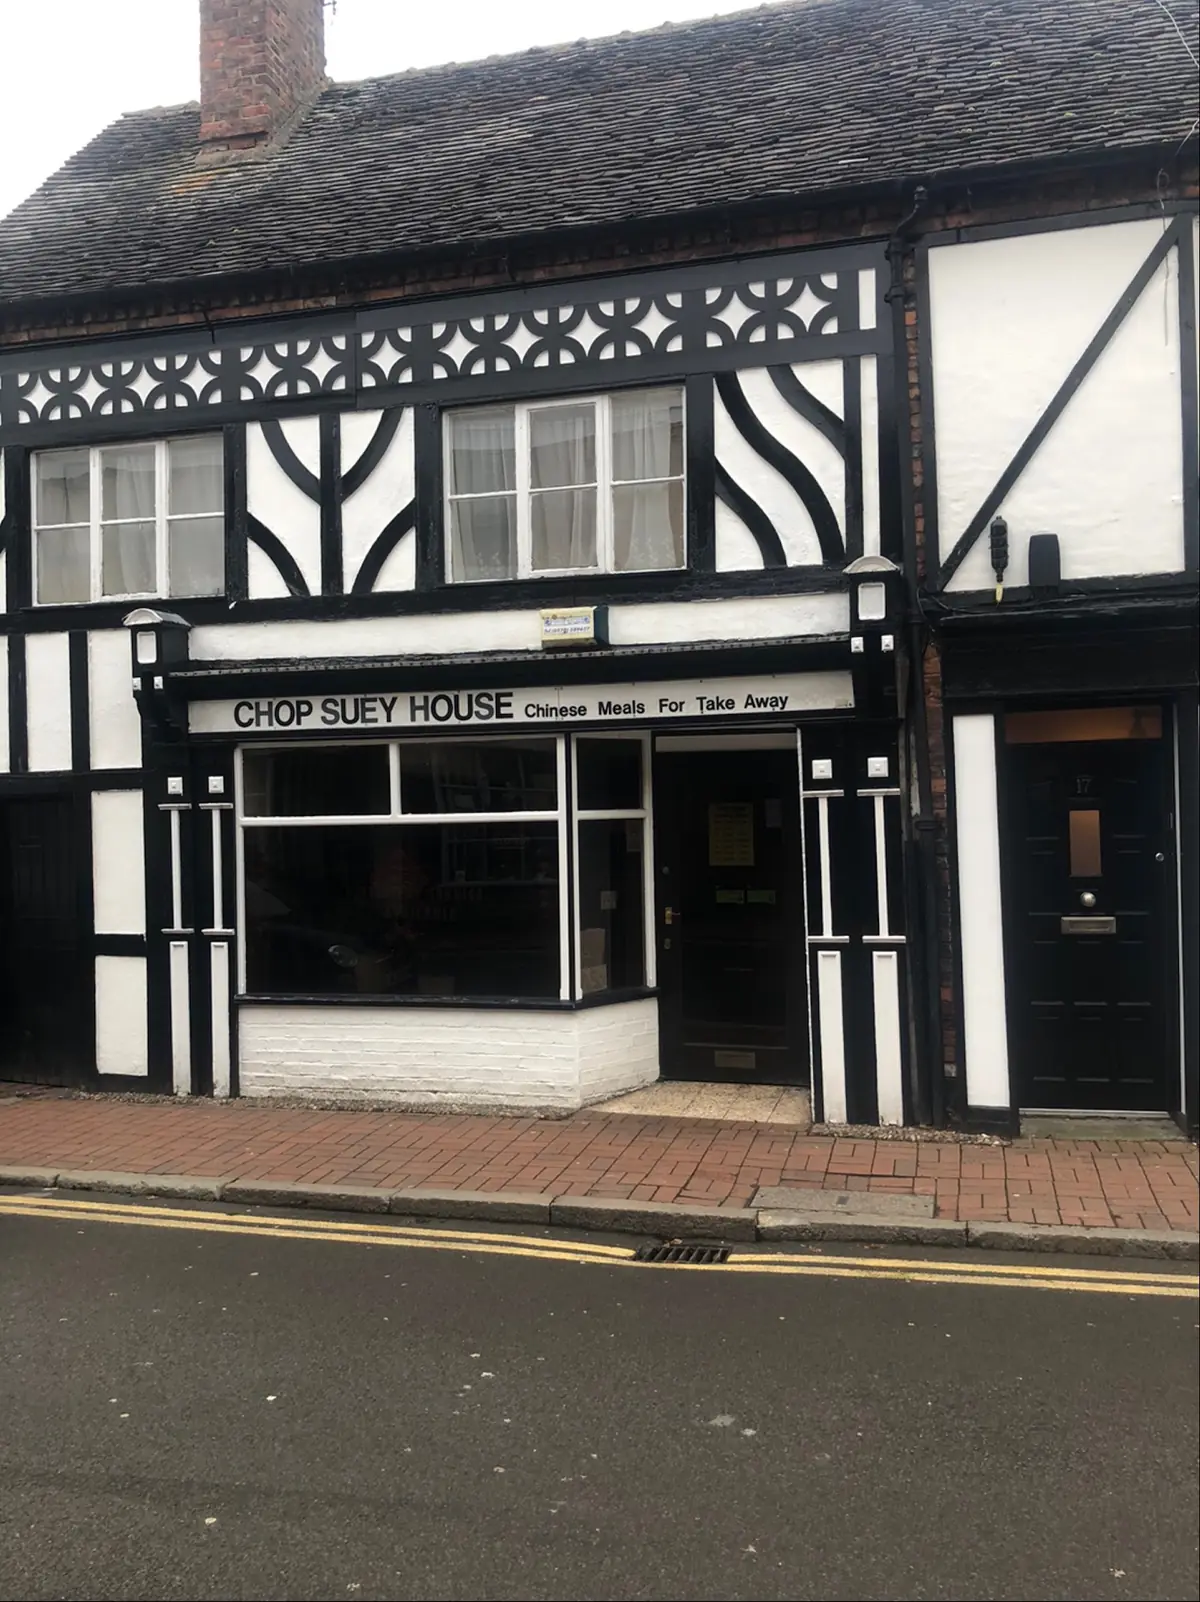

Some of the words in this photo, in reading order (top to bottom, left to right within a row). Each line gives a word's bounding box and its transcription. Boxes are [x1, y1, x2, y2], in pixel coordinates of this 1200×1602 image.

[234, 700, 313, 728] CHOP
[321, 697, 398, 725] SUEY
[409, 692, 514, 722] HOUSE
[524, 703, 587, 718] Chinese
[598, 700, 646, 716] Meals
[658, 698, 686, 713] For
[696, 696, 735, 712] Take
[744, 694, 789, 710] Away
[1076, 777, 1092, 793] 17
